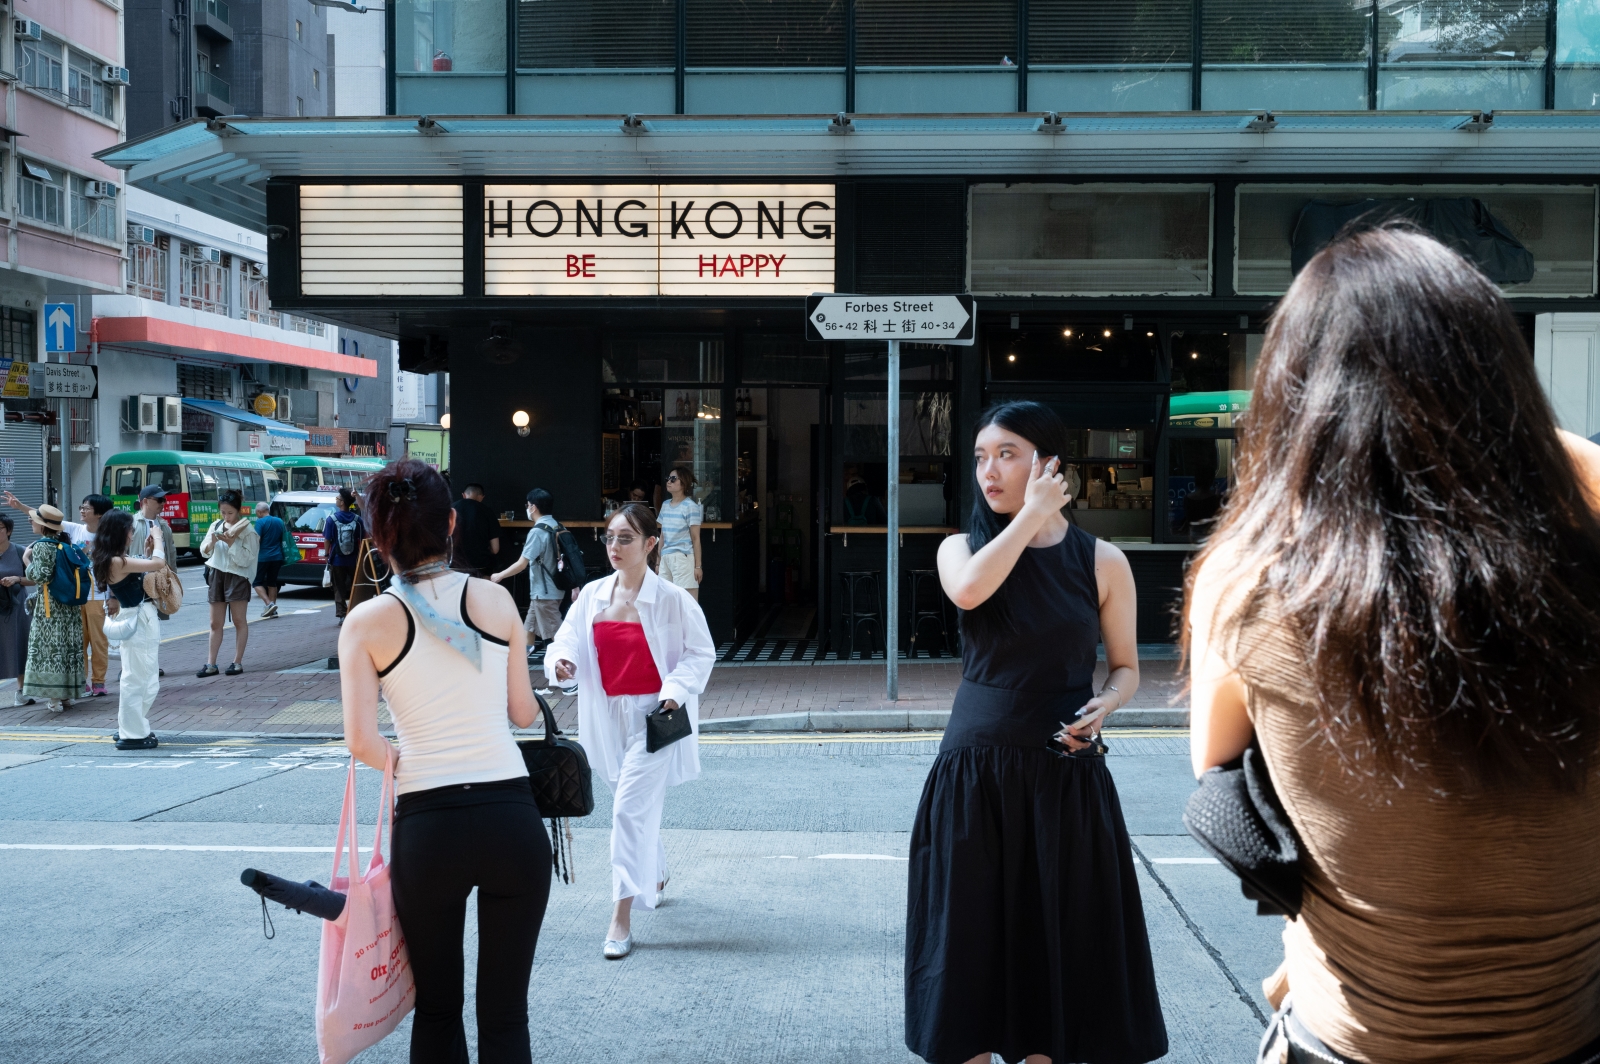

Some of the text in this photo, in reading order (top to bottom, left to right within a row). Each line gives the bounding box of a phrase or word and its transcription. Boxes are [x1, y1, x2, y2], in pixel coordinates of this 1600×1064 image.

[488, 199, 832, 240] HONG KONG
[566, 254, 786, 278] BE HAPPY
[845, 301, 934, 312] Forbes Street
[863, 319, 916, 334] 科士街
[46, 367, 80, 378] Davis Street
[354, 948, 364, 960] 20
[363, 1020, 374, 1028] rue
